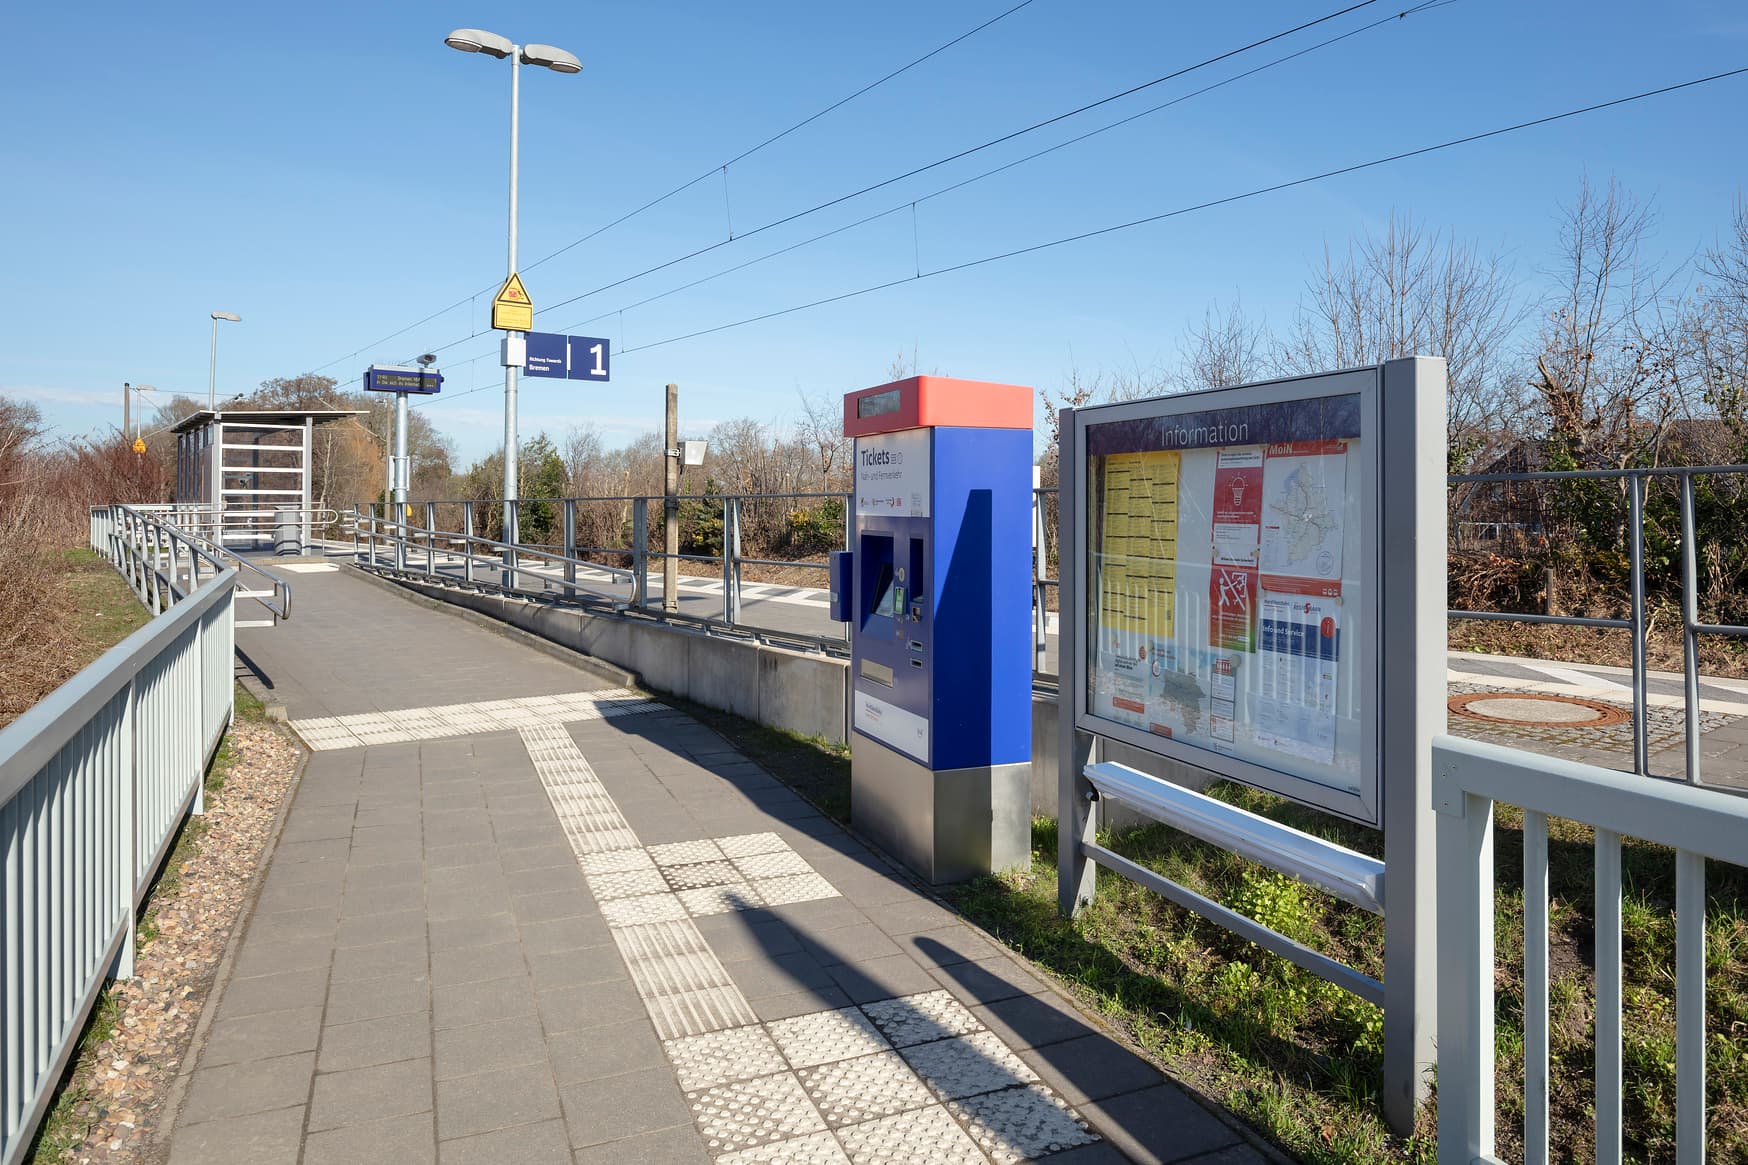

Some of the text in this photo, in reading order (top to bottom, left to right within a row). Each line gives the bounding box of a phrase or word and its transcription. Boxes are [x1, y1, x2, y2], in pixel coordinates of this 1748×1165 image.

[529, 364, 550, 372] Bremen
[590, 343, 607, 376] 1
[1162, 420, 1248, 447] Information
[861, 447, 890, 466] Tickets
[1269, 443, 1292, 455] MoiN
